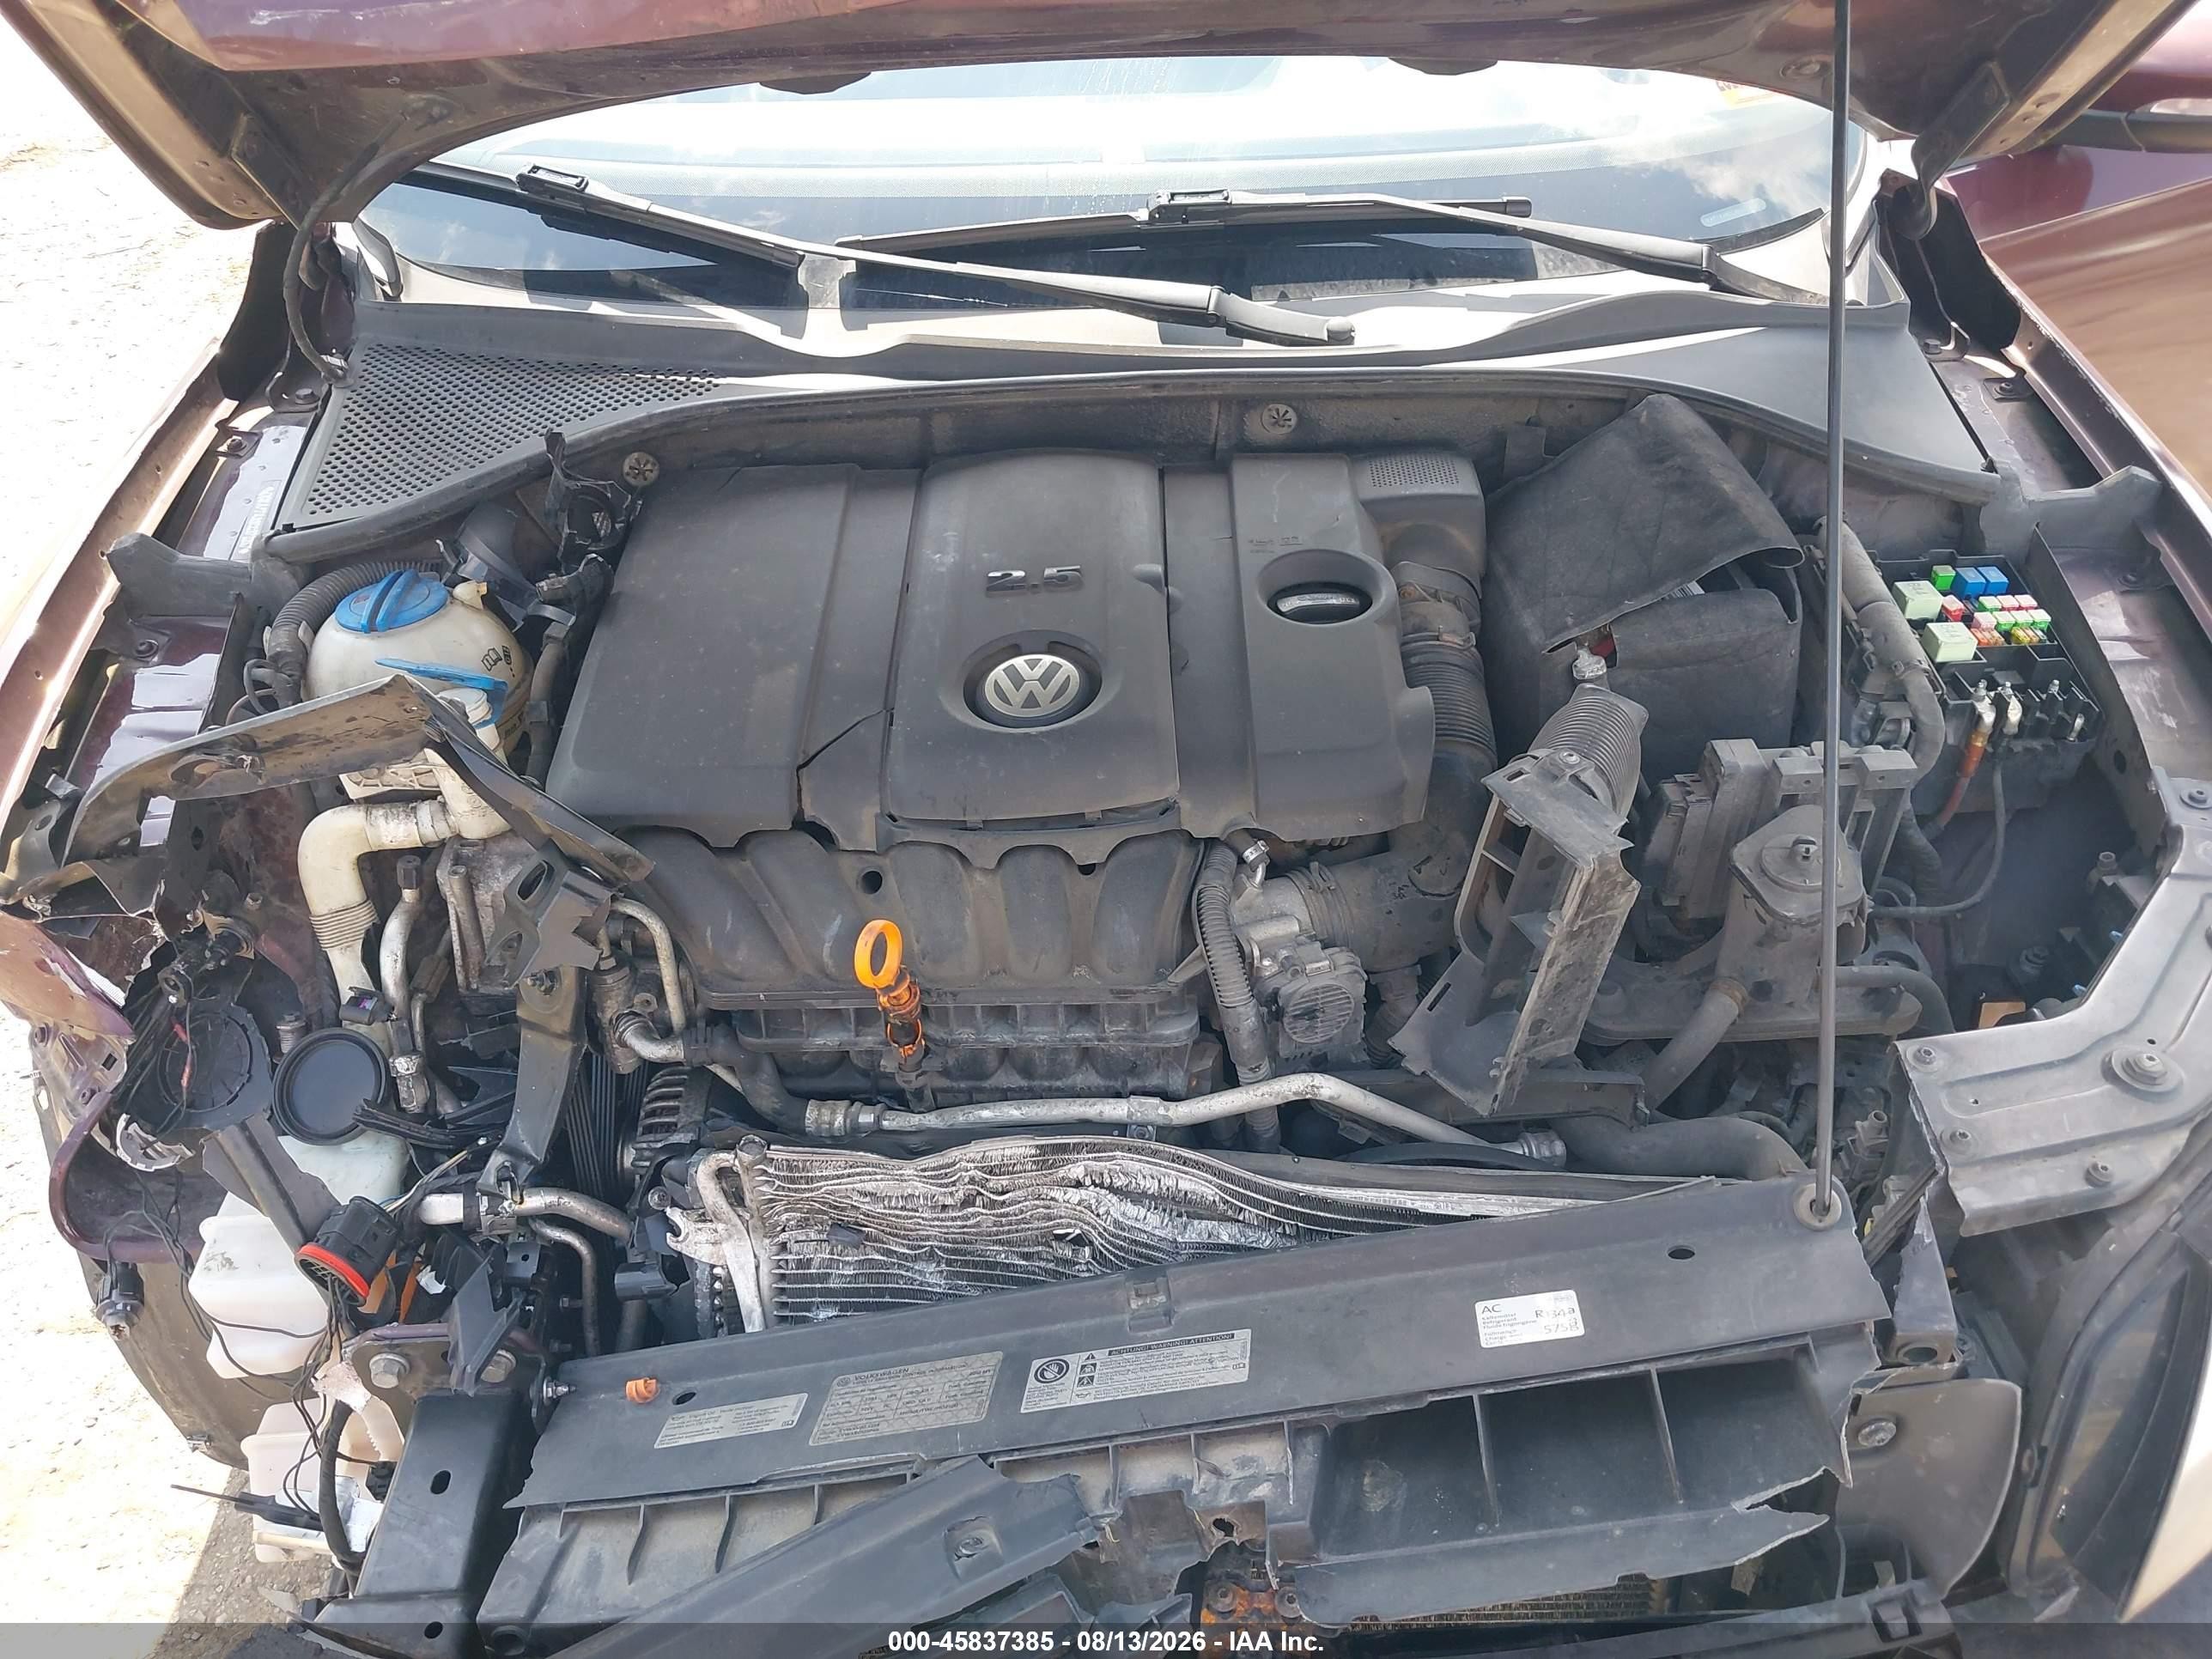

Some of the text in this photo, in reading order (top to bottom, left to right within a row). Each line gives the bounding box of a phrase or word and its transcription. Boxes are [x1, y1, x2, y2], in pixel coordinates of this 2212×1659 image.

[985, 565, 1083, 594] 2.5
[988, 655, 1077, 714] VW
[1481, 1304, 1502, 1314] AC
[1111, 1334, 1234, 1355] ACHTUNG! WARNING! ATTENTION!
[854, 1367, 909, 1381] VOLKSWAGEN
